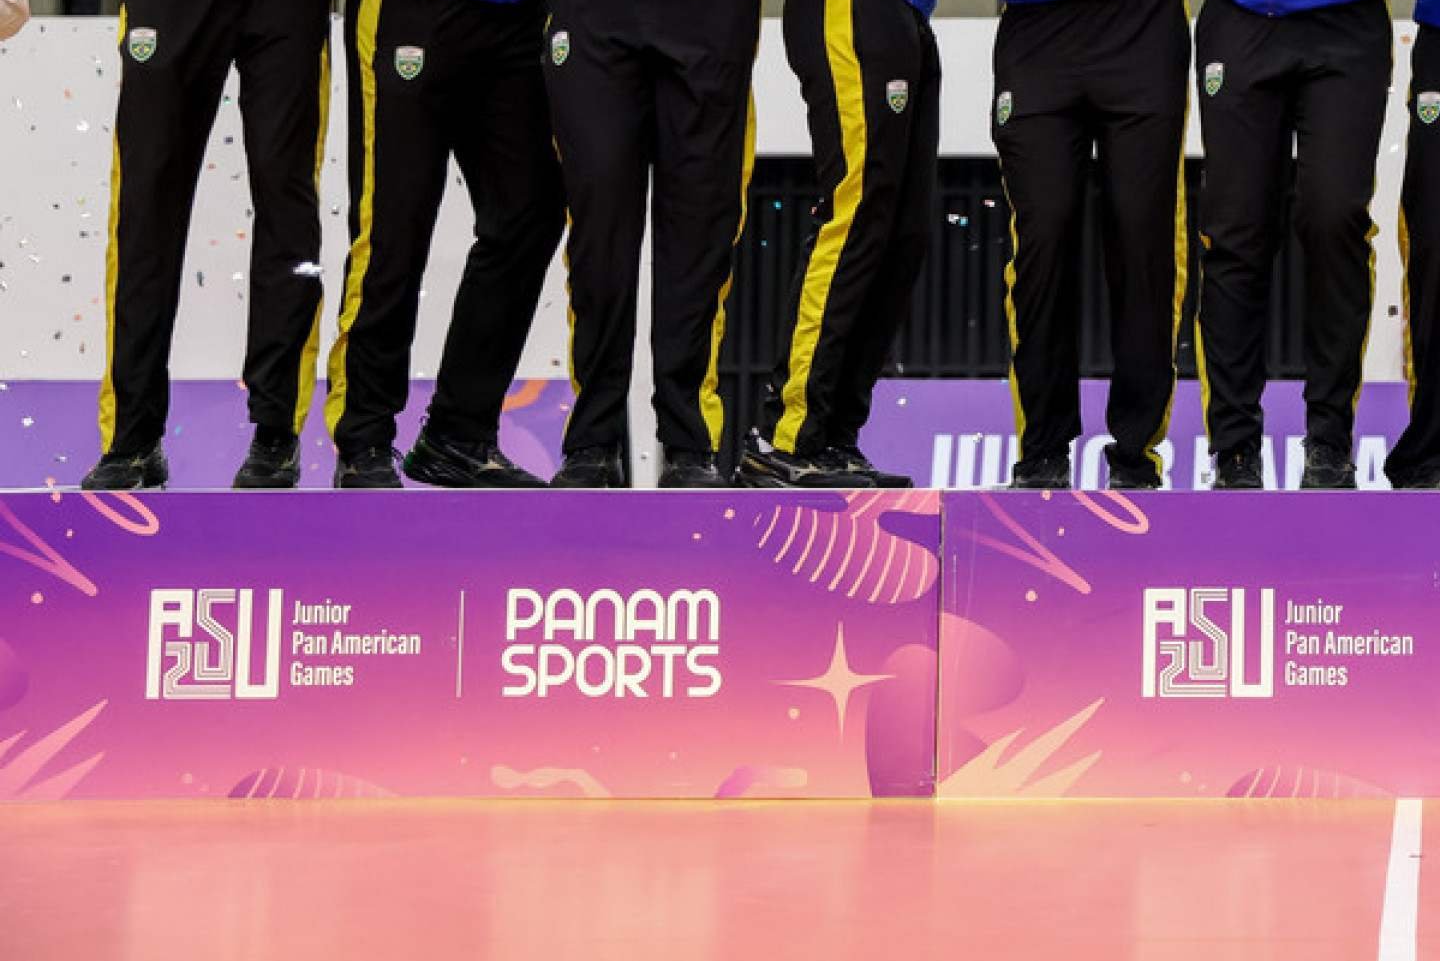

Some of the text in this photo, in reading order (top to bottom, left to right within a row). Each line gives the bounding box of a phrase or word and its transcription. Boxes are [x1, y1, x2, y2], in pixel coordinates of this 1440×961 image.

[292, 599, 352, 625] Junior
[505, 587, 720, 642] PANAM
[1284, 600, 1344, 625] Junior
[291, 629, 422, 655] Pan American
[1284, 629, 1414, 655] Pan American
[290, 660, 355, 687] Games
[500, 643, 723, 699] SPORTS
[1283, 660, 1349, 687] Games
